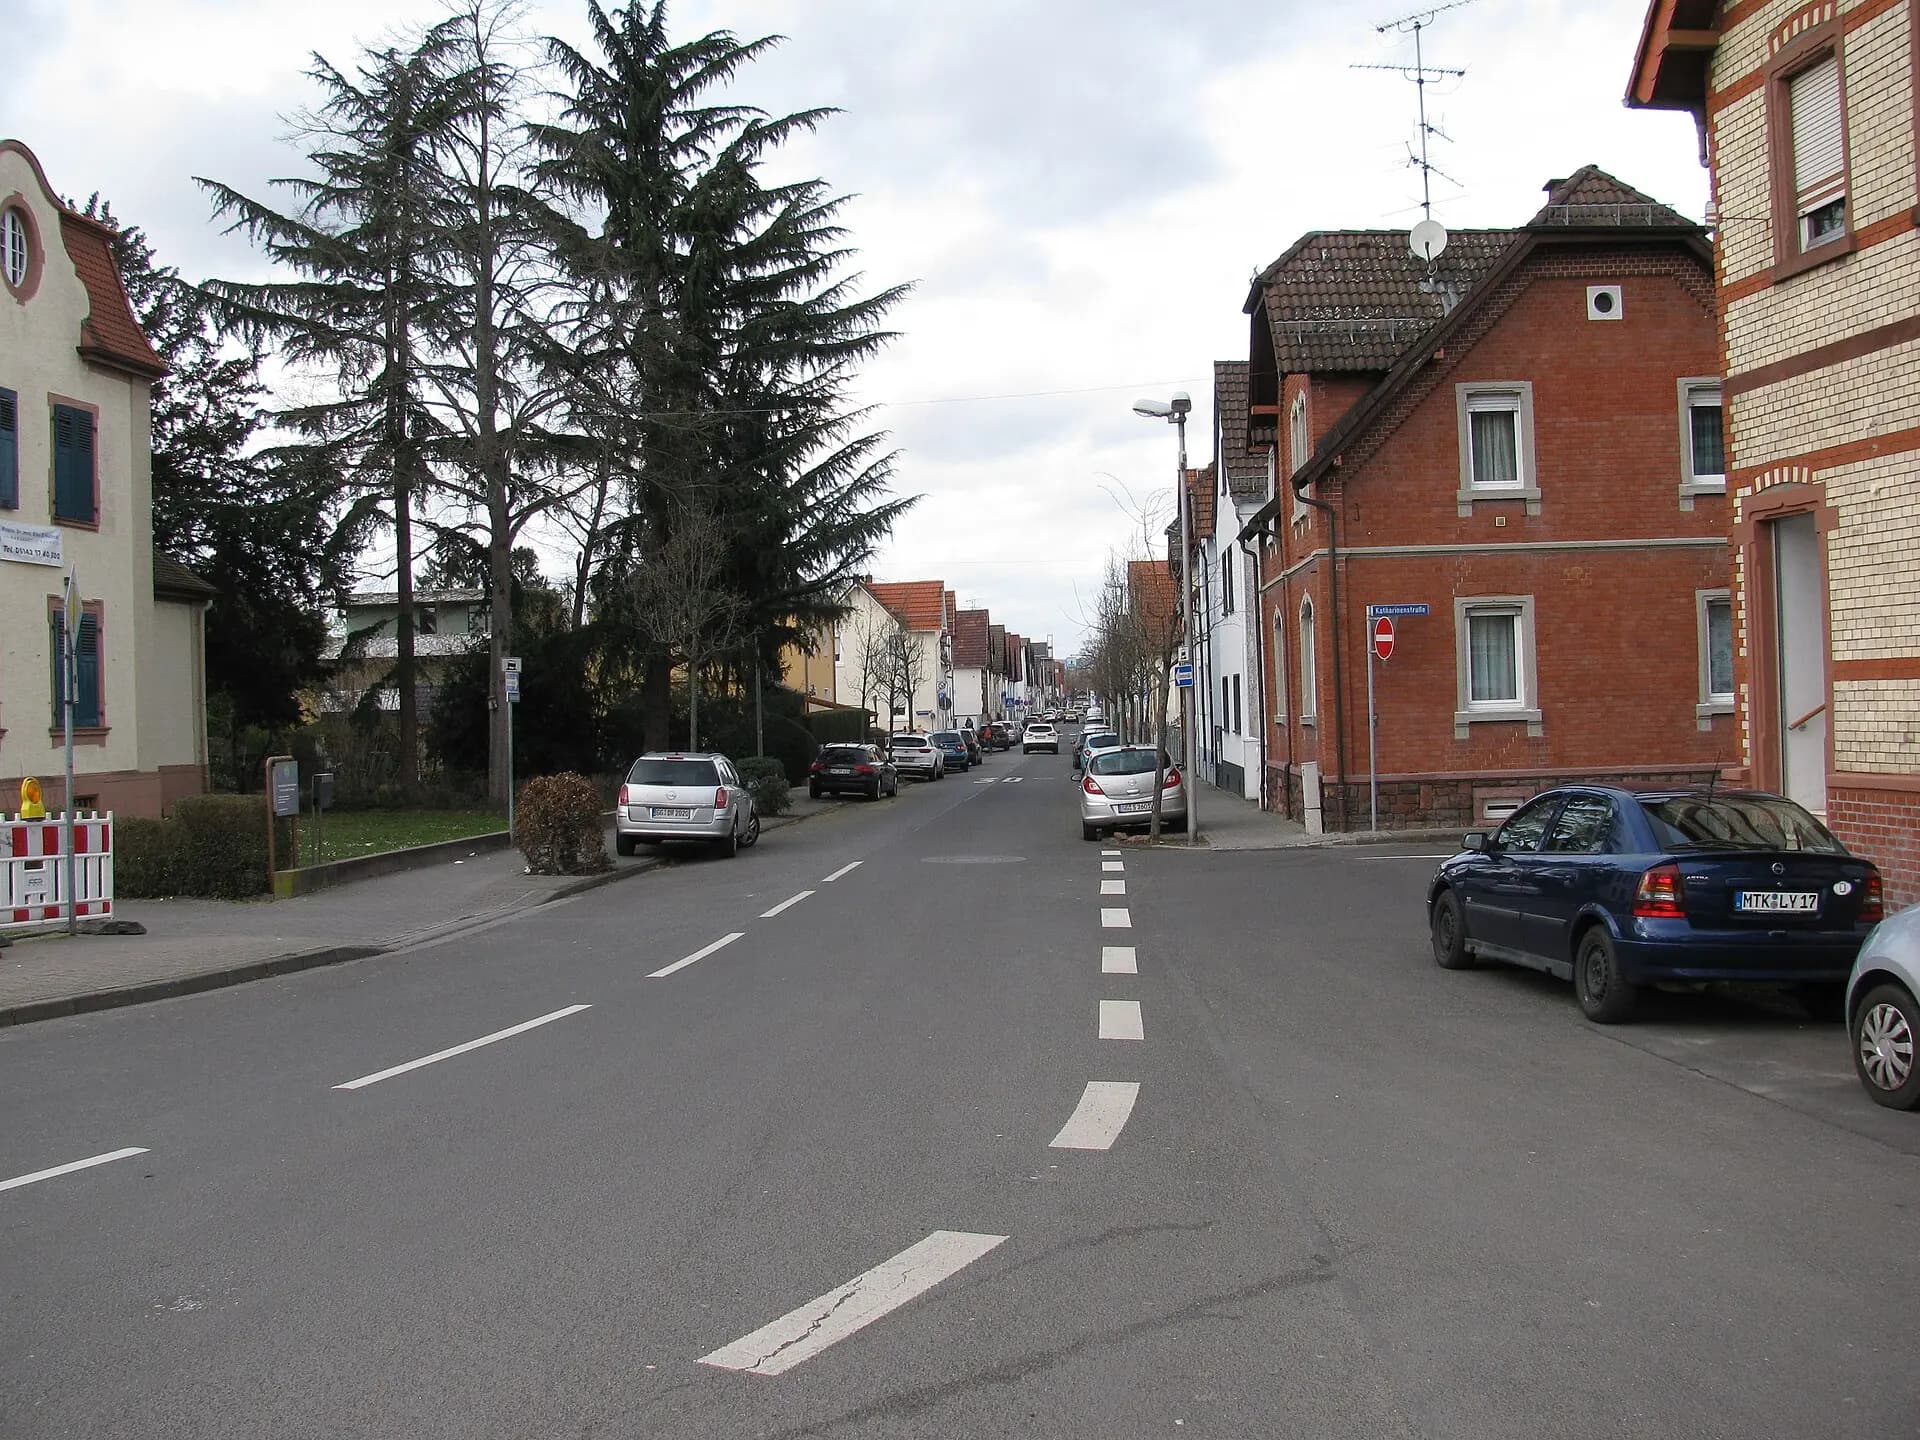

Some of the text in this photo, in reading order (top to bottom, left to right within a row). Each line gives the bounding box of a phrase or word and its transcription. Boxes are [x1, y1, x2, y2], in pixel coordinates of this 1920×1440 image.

[1375, 606, 1426, 615] Katharinenstraße
[1743, 893, 1817, 909] MTK LY 17
